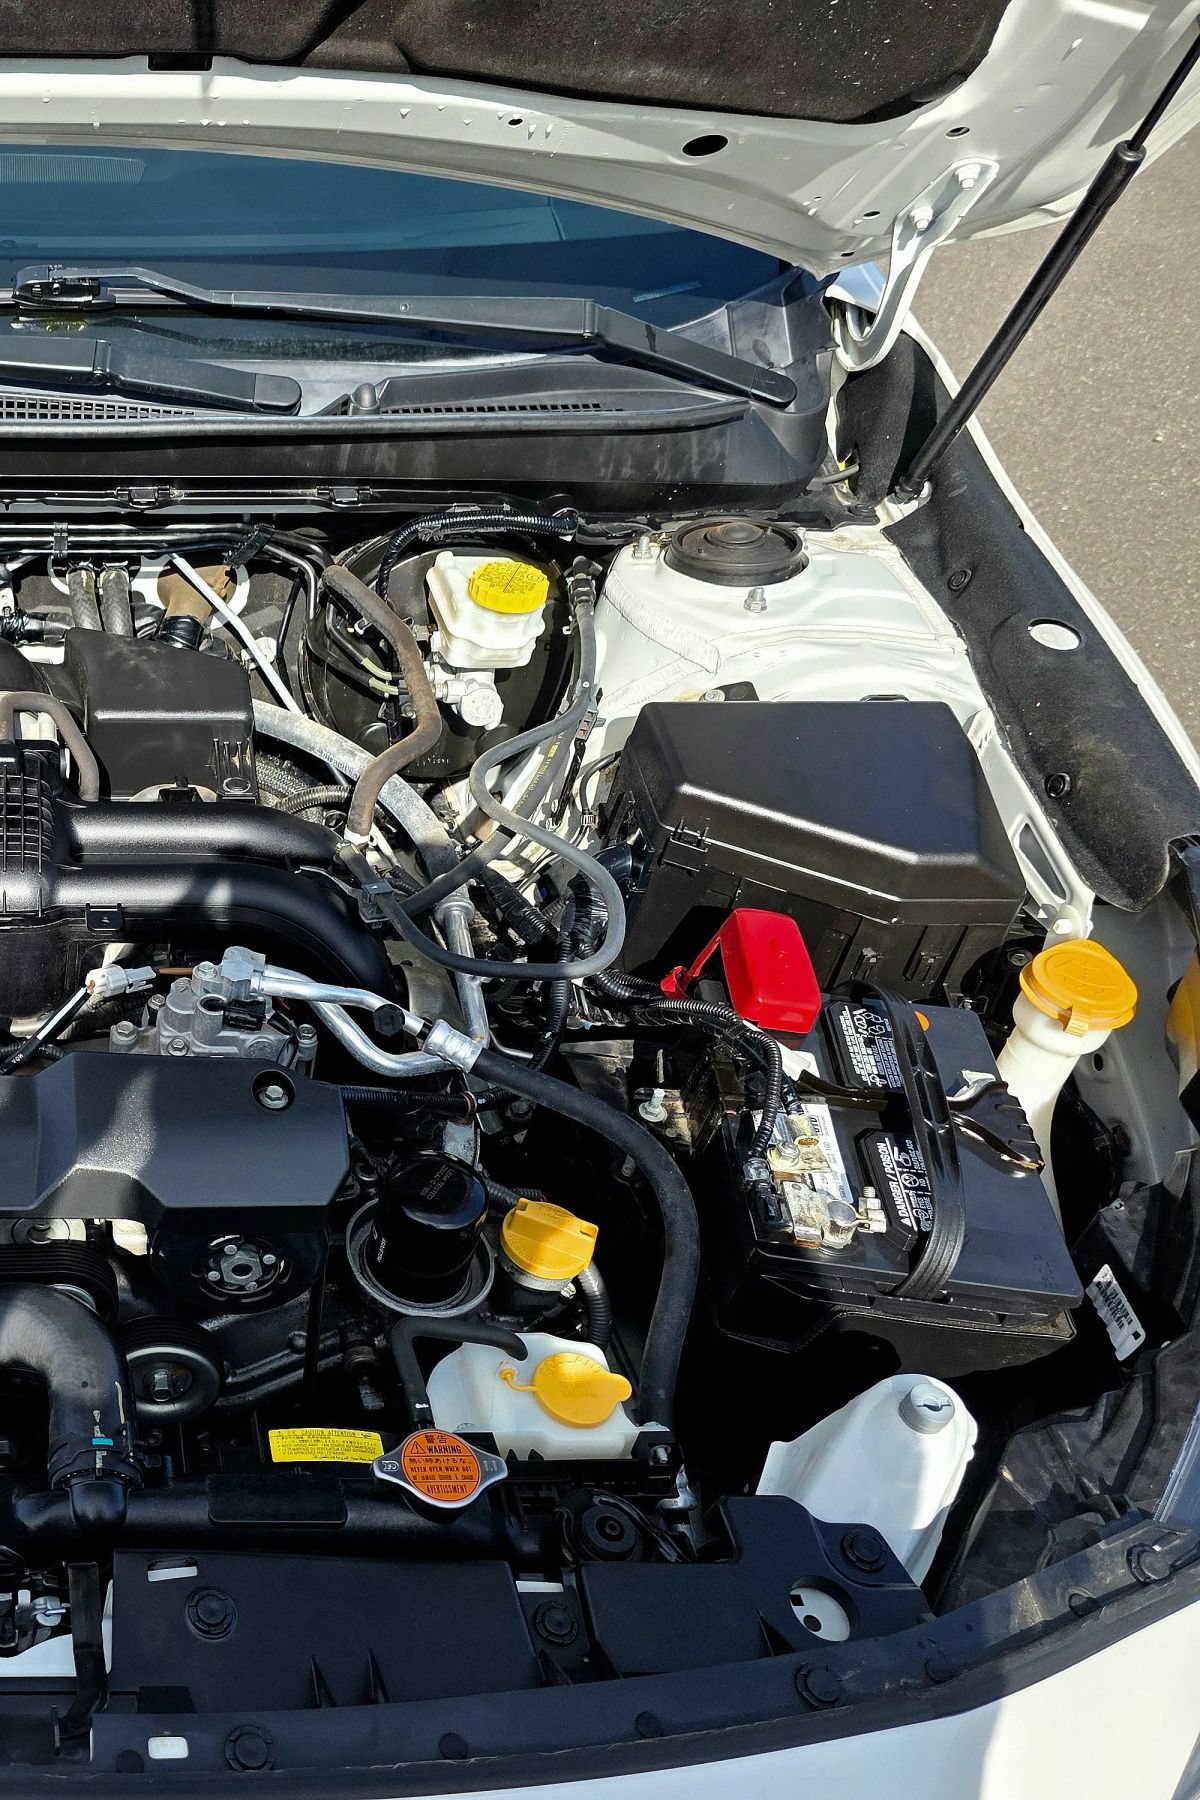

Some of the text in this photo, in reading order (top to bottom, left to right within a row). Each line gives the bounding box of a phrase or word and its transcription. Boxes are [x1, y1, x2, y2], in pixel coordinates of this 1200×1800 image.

[877, 1142, 895, 1174] POISON
[889, 1181, 909, 1218] DANGER
[425, 1435, 447, 1443] 警告
[427, 1444, 461, 1454] WARNING
[427, 1484, 467, 1494] AVERTISSMENT
